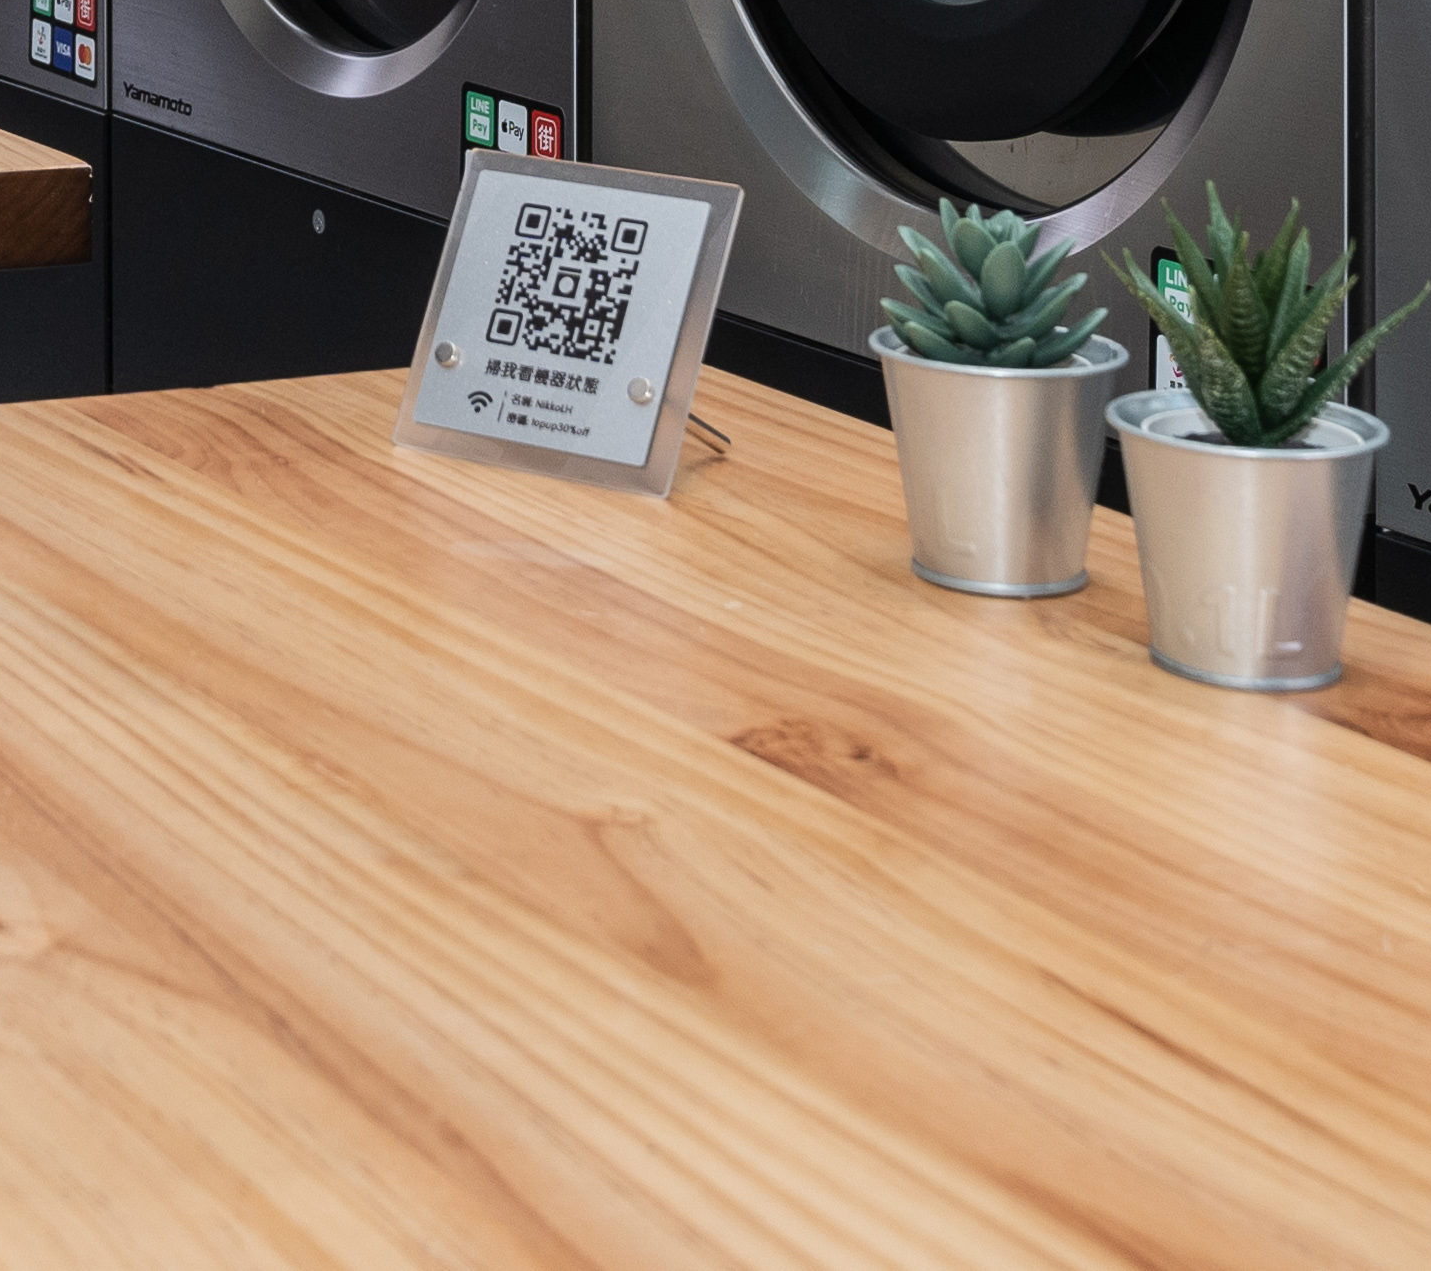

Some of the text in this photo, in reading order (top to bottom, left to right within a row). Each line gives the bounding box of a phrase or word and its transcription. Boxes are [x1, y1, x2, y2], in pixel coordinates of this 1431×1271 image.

[56, 41, 71, 57] VISA
[123, 81, 193, 118] Yamamoto
[470, 97, 490, 114] LINE
[472, 119, 487, 136] Pay
[509, 121, 524, 141] Pay
